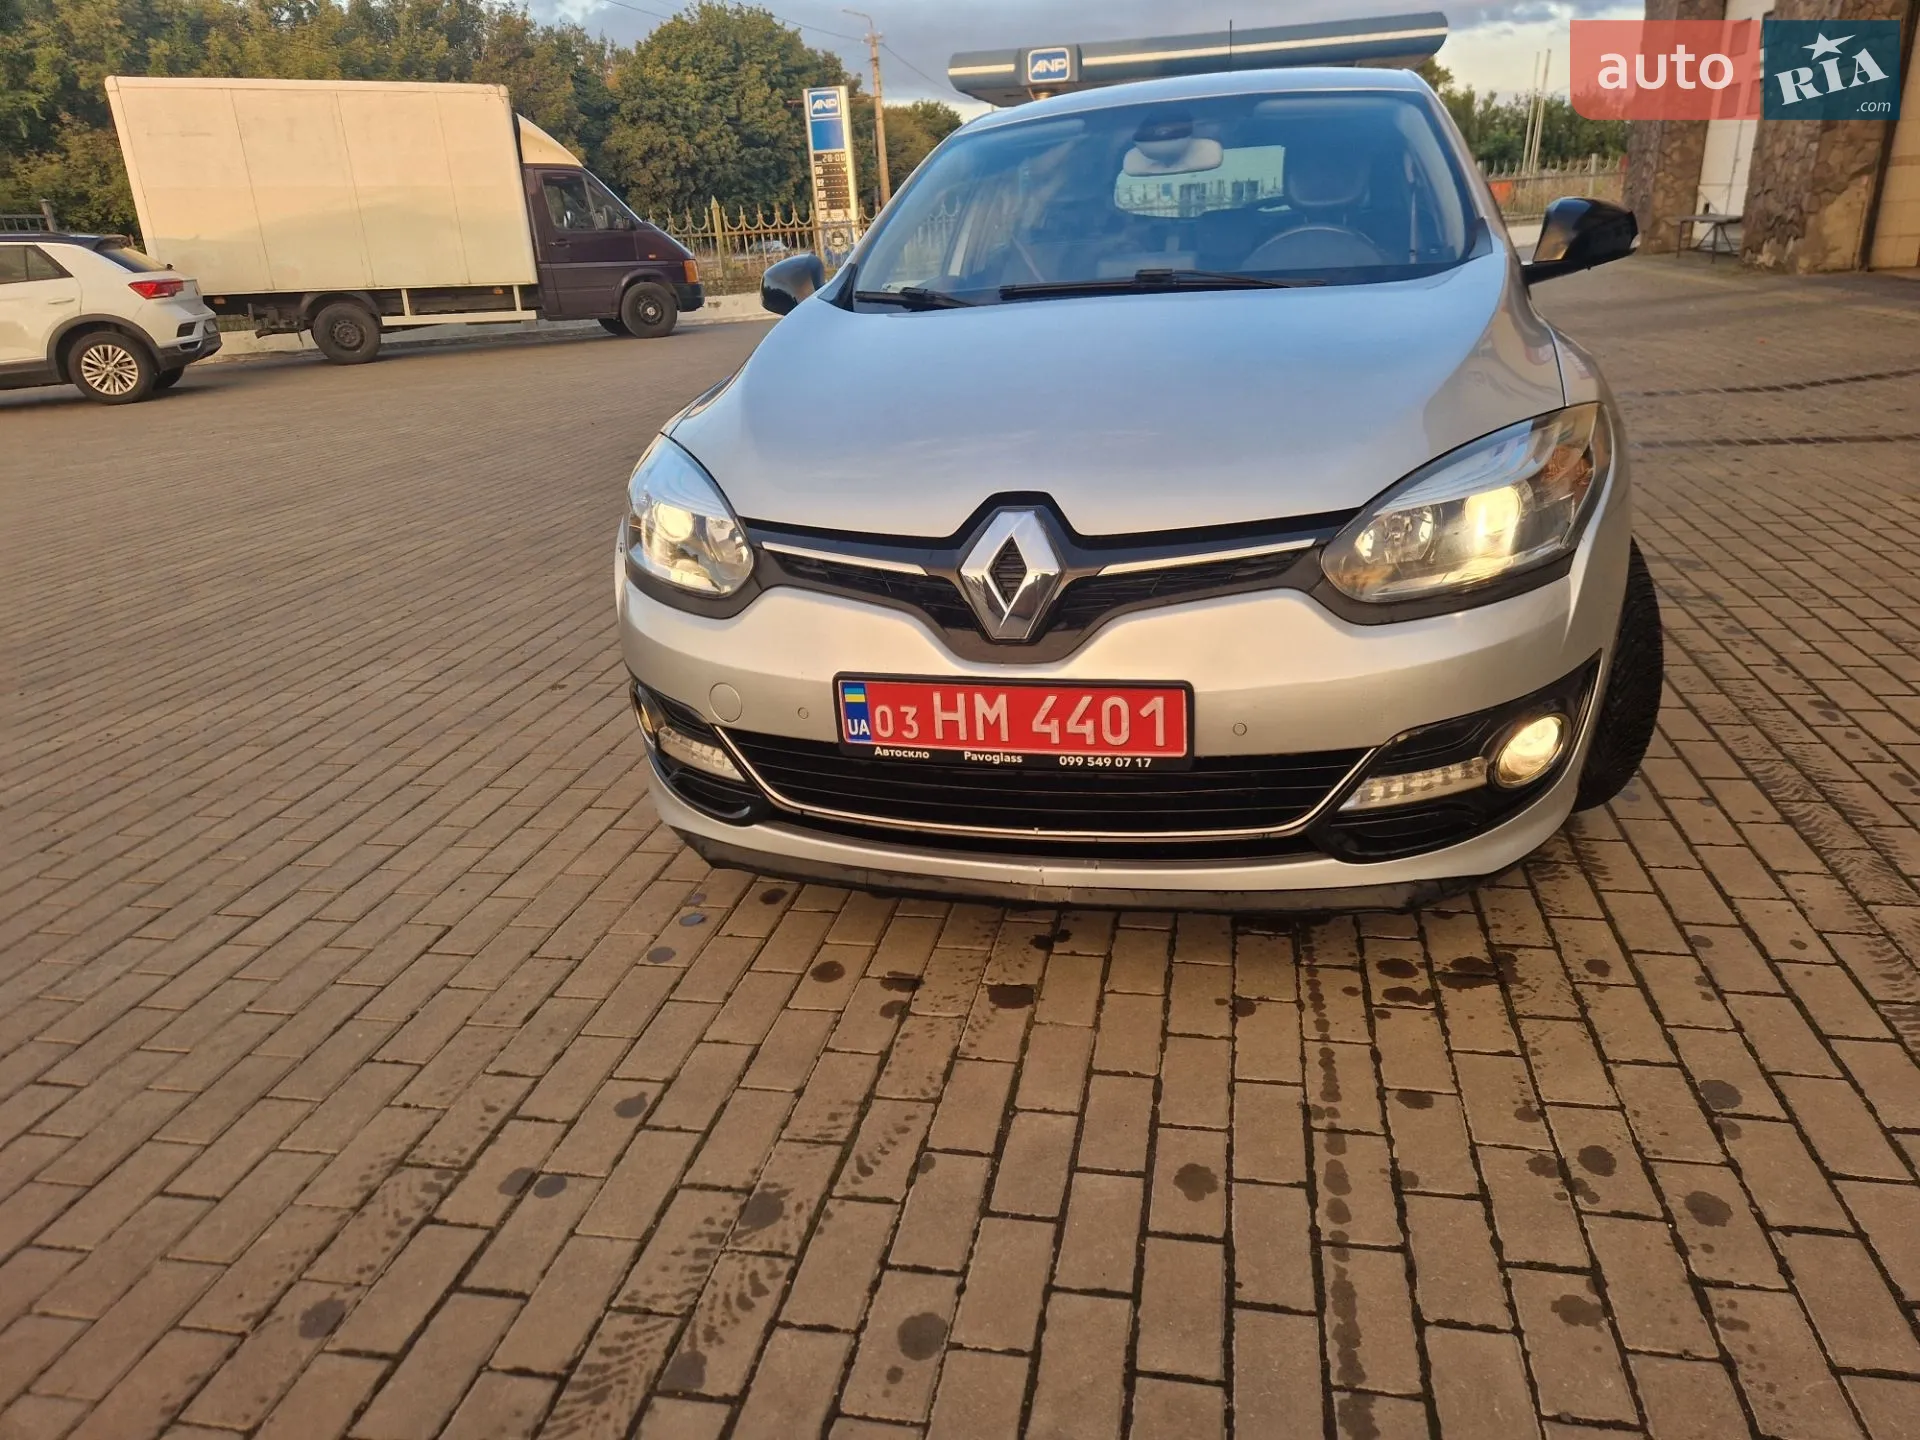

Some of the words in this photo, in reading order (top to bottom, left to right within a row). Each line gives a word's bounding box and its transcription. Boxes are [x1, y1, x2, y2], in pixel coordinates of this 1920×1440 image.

[1031, 58, 1067, 74] ANP
[847, 718, 870, 736] UA
[874, 705, 920, 739] 03
[932, 691, 1010, 742] HM
[1031, 695, 1166, 747] 4401
[874, 746, 930, 760] Автоскло
[964, 751, 1023, 765] Pavoglass
[1059, 755, 1085, 766] 099
[1087, 756, 1112, 767] 549
[1115, 757, 1132, 768] 07
[1135, 757, 1152, 769] 17
